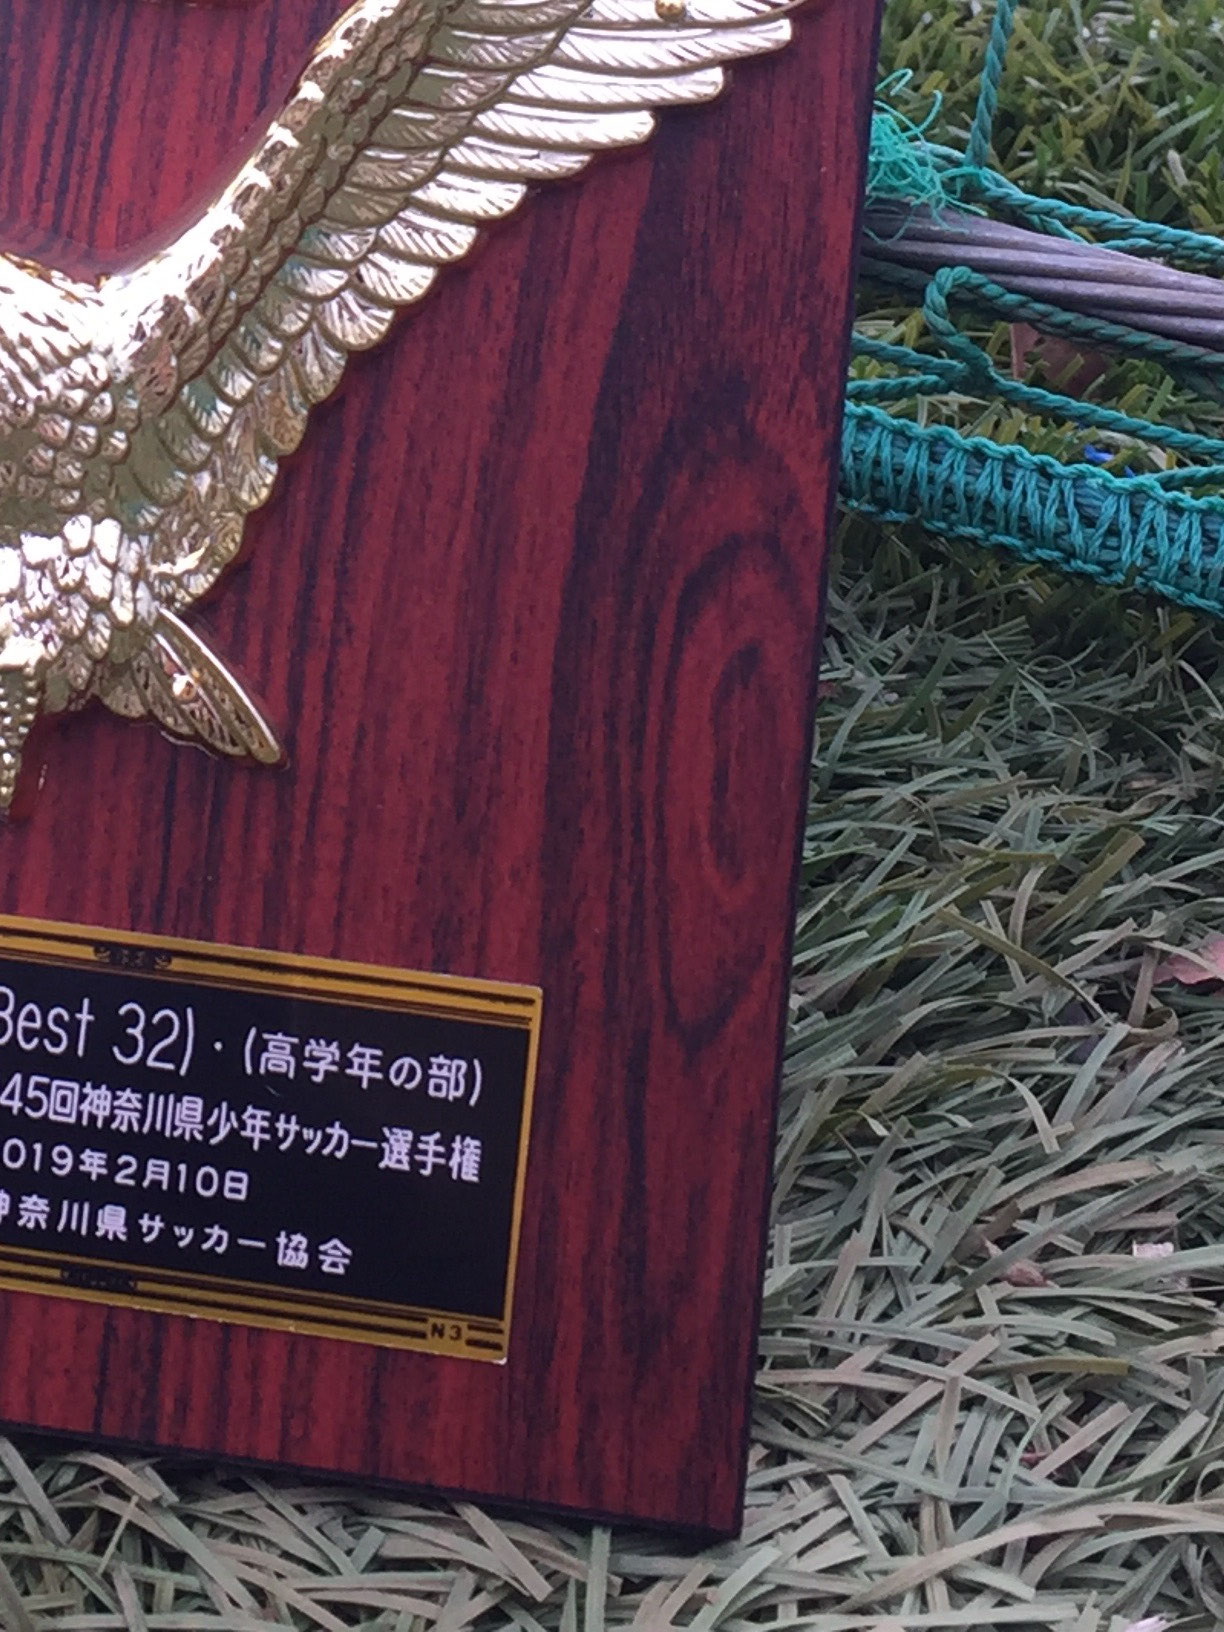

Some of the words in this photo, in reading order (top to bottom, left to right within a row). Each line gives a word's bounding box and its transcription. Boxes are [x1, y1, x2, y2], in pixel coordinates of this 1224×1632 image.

[112, 1001, 195, 1077] 32)
[244, 1026, 483, 1106] (高学年の部)
